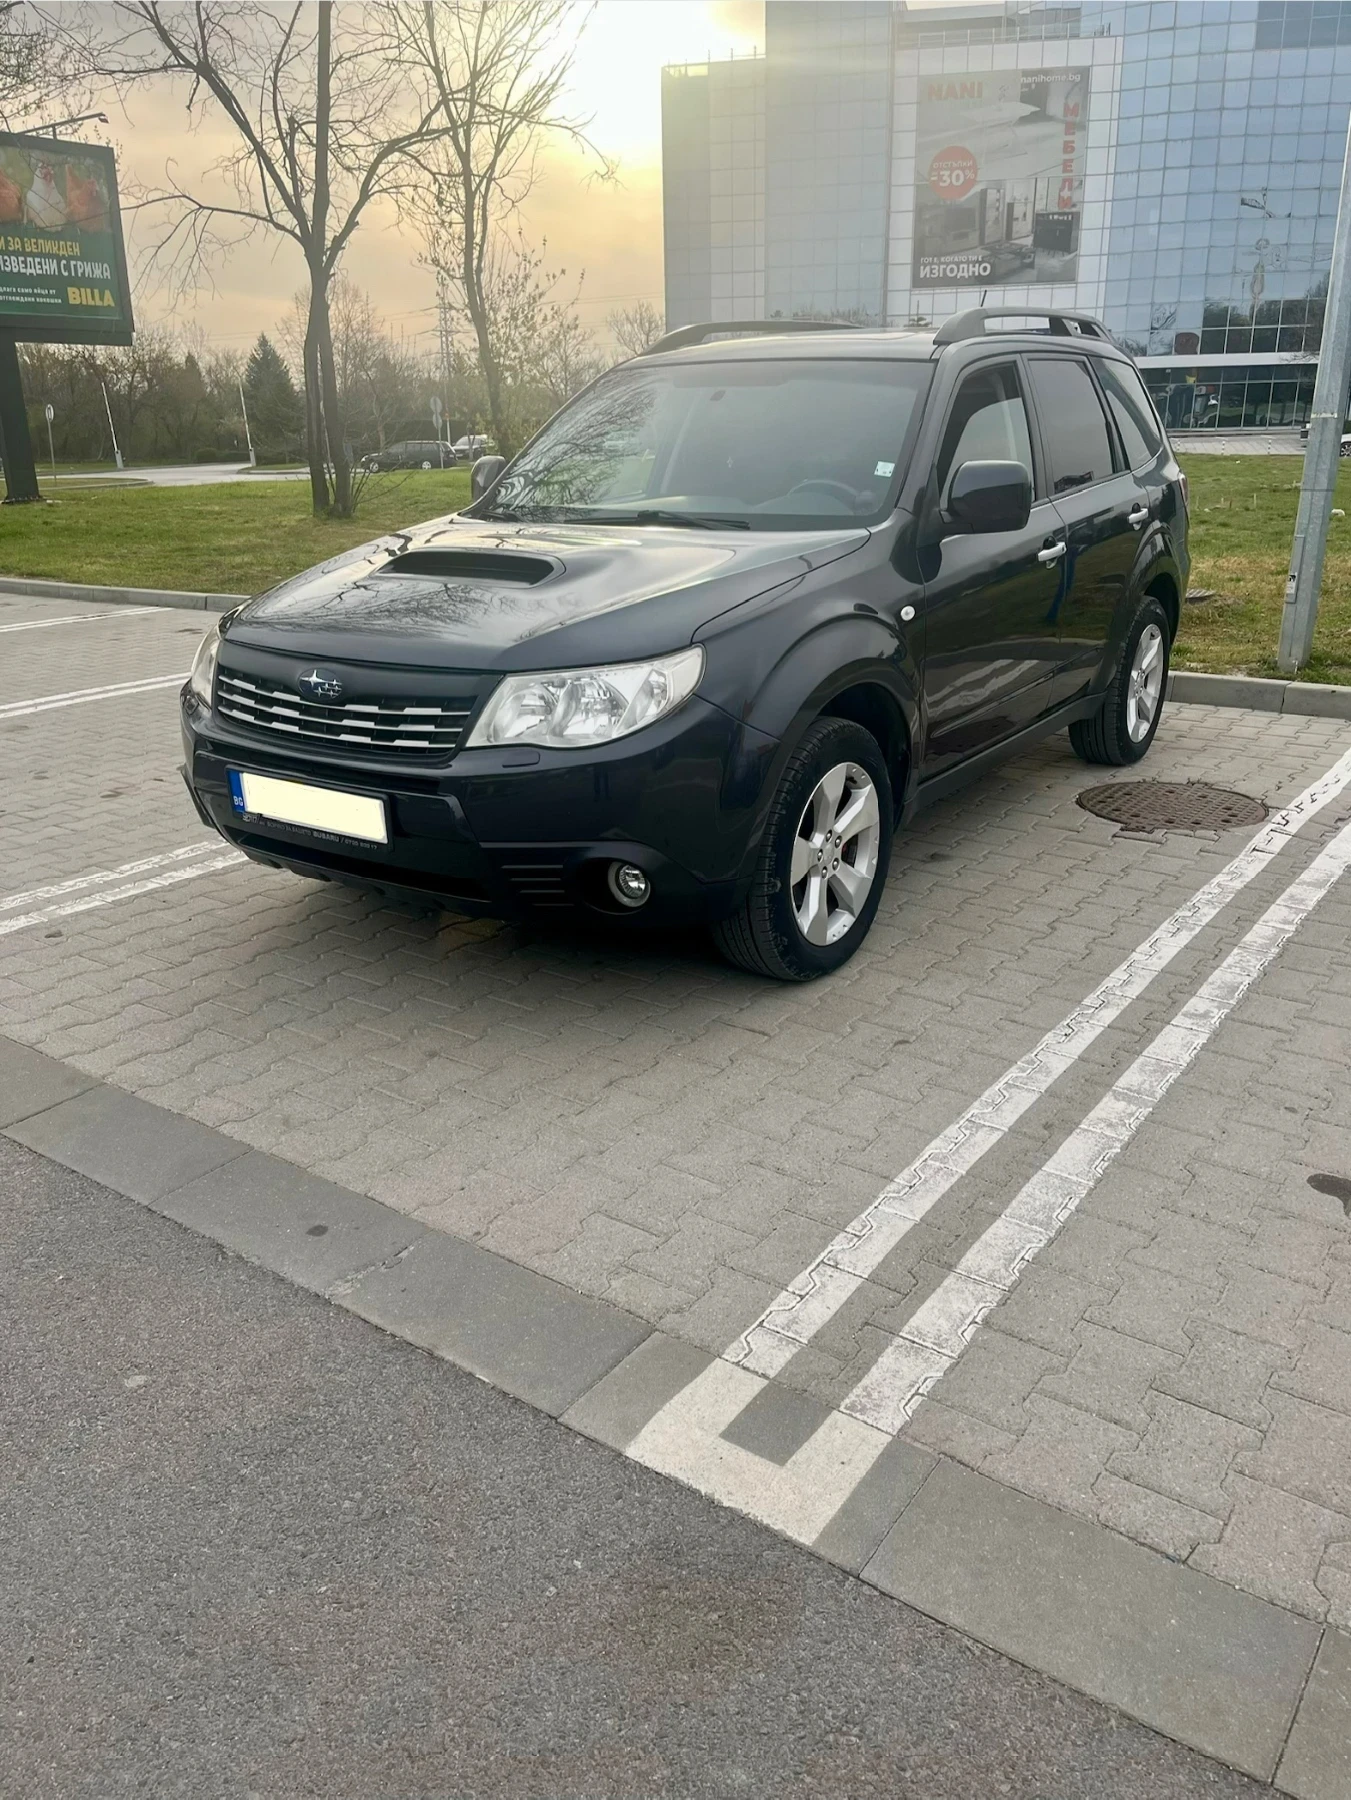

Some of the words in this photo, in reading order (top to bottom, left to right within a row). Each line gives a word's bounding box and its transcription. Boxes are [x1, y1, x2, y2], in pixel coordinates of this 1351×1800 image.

[1020, 73, 1081, 83] nanihome.bg
[928, 81, 983, 101] NANI
[932, 160, 973, 168] ОТСТЪПКИ
[1057, 102, 1080, 210] МЕБЕЛИ
[7, 236, 22, 252] ЗА
[24, 237, 80, 257] ВЕЛИКДЕН
[941, 255, 967, 263] КОГАТО
[60, 260, 69, 277] С
[70, 260, 111, 280] ГРИЖА
[919, 262, 991, 279] ИЗГОДНО
[67, 286, 115, 307] BILLA
[233, 795, 244, 807] BG
